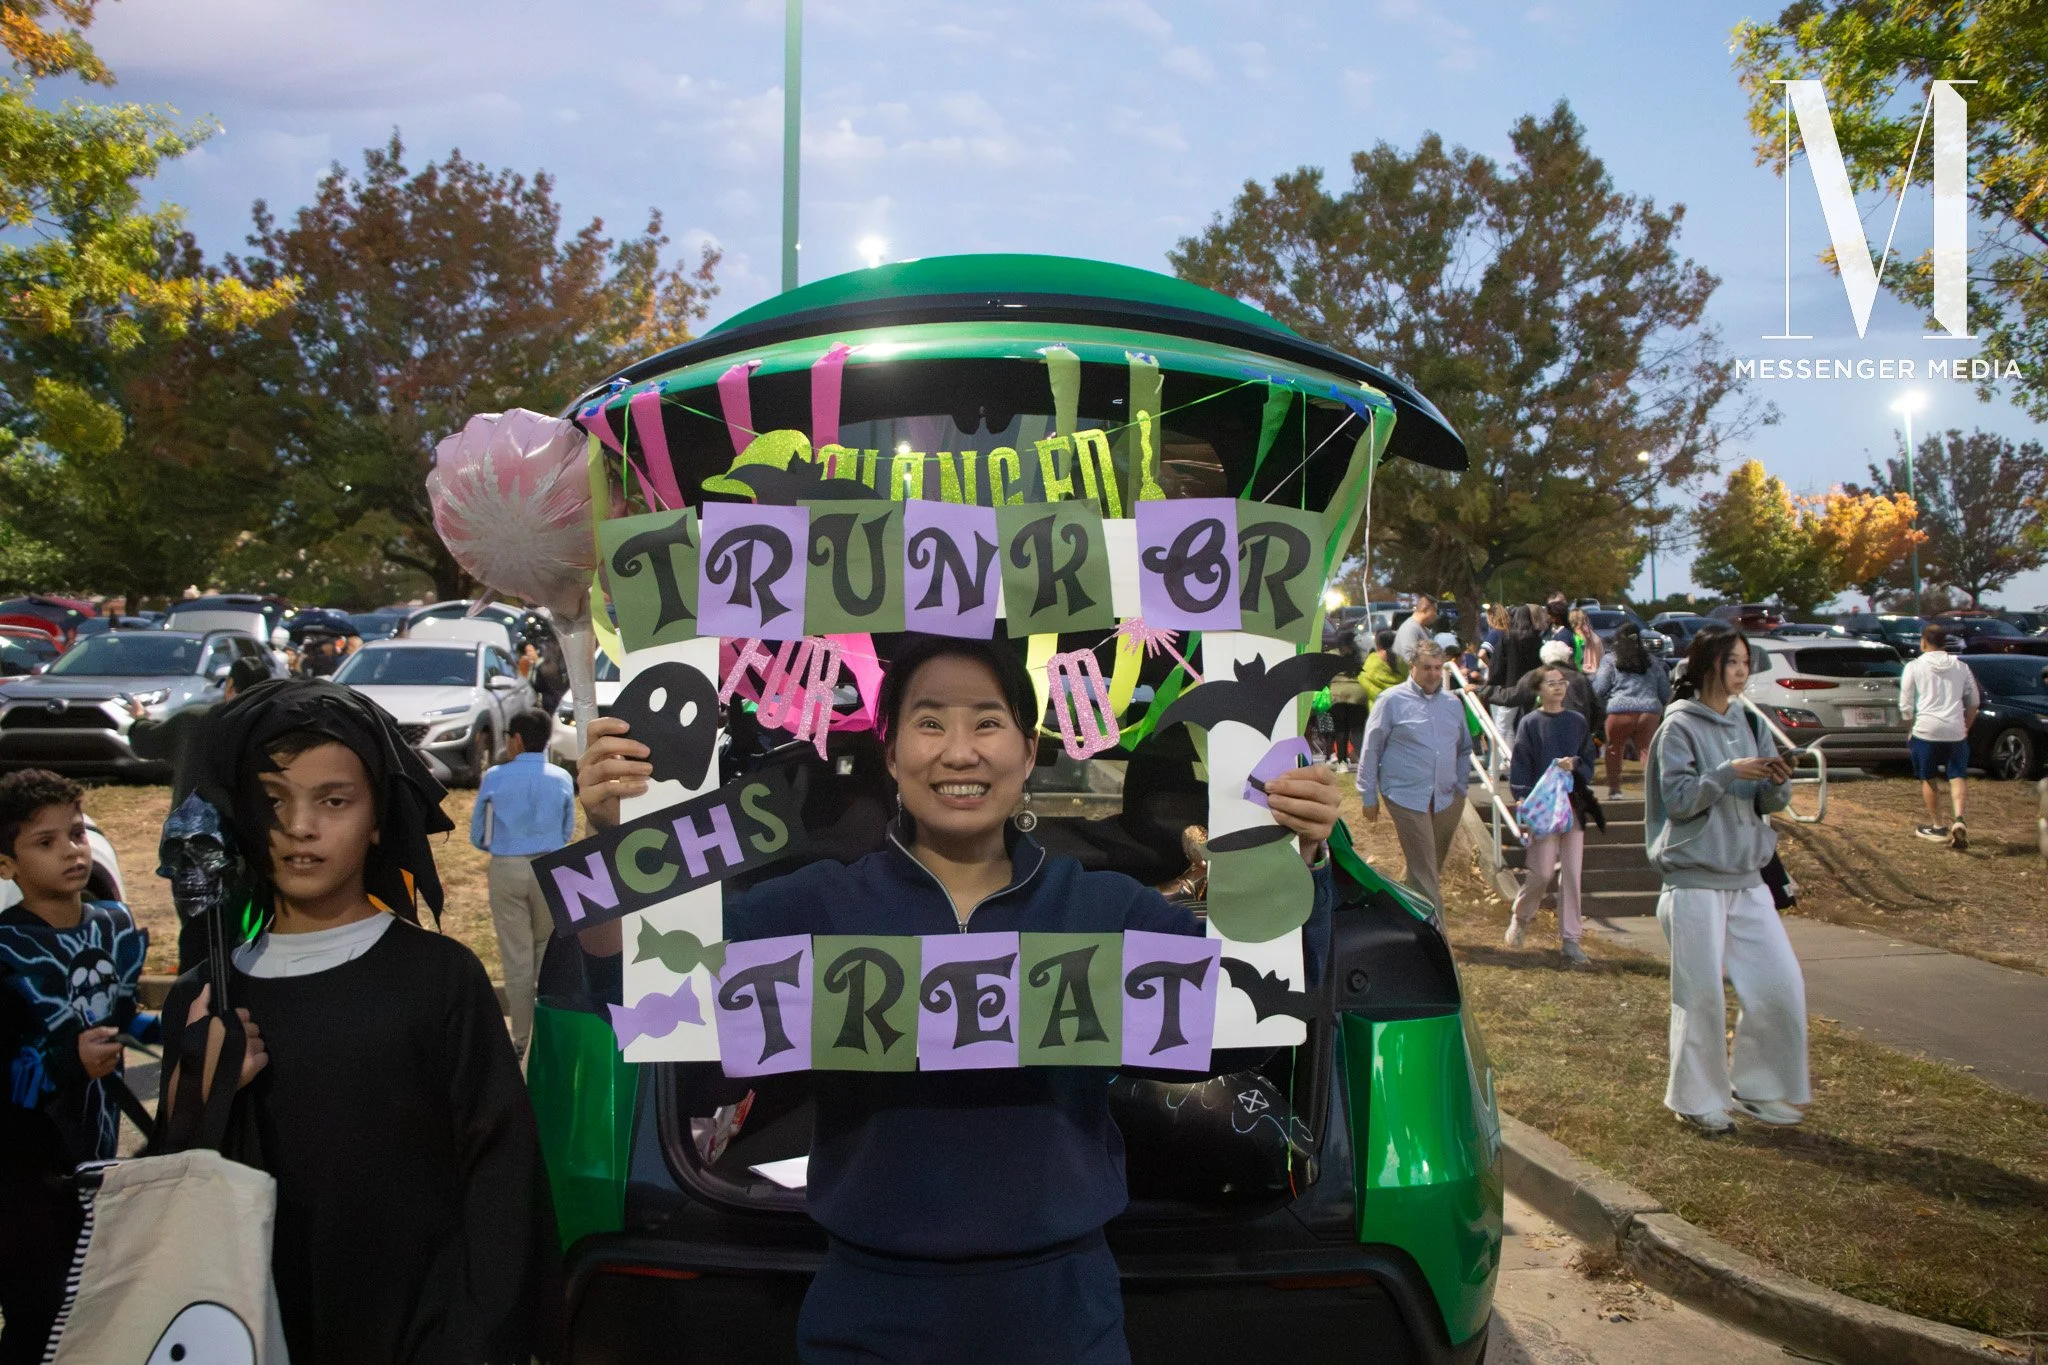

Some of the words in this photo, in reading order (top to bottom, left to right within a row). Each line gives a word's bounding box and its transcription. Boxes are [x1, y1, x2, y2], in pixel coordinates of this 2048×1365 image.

[612, 509, 1096, 634] TRUNK
[1142, 517, 1312, 626] OR
[551, 783, 789, 921] NCHS
[718, 944, 1212, 1064] TREAT
